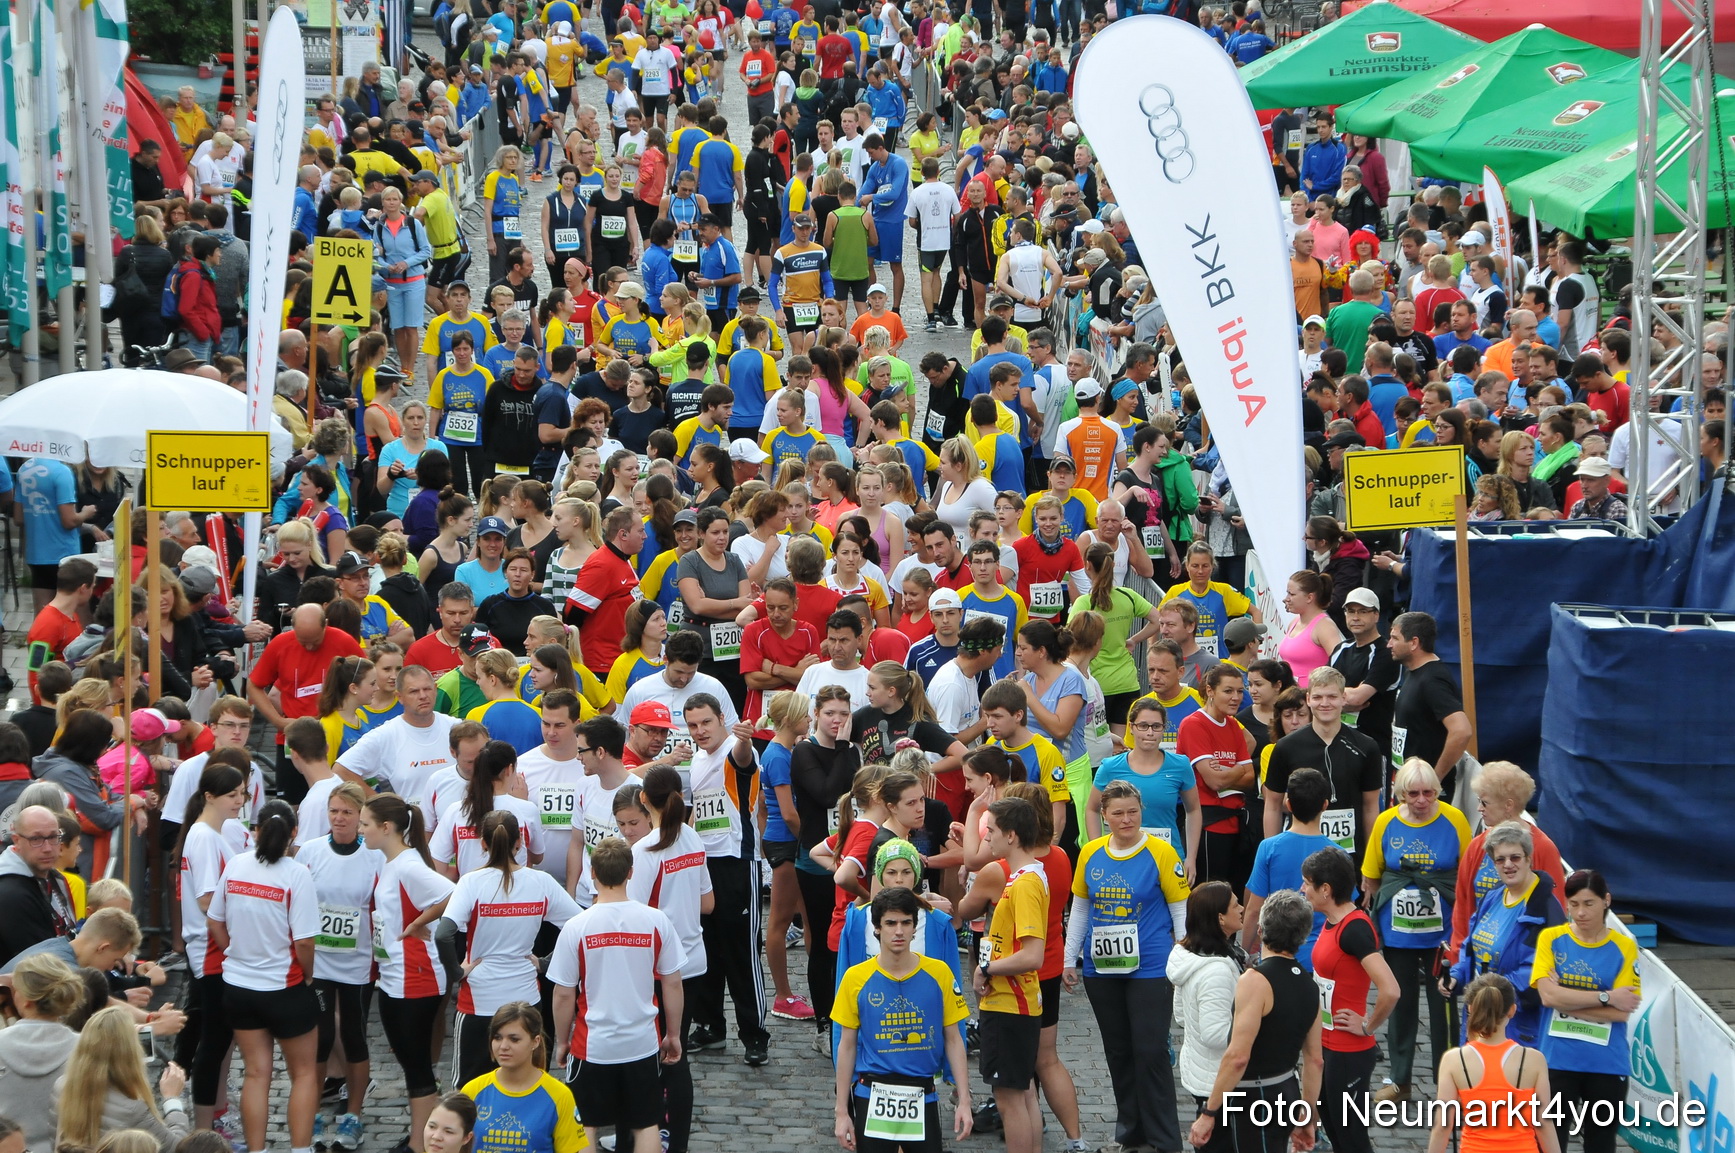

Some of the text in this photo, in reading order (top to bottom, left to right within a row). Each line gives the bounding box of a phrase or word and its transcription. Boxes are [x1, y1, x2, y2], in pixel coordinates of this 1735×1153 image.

[1344, 55, 1429, 67] Neumarkter
[1512, 127, 1589, 141] Neumarkter
[1482, 134, 1587, 154] Lammsbräu
[604, 221, 624, 230] 5227
[557, 234, 577, 243] 3409
[319, 238, 366, 260] Block
[679, 245, 693, 254] 140
[325, 264, 357, 307] A
[796, 307, 816, 317] 5147
[448, 418, 475, 431] 5532
[9, 439, 72, 457] Audi BKK
[156, 453, 261, 474] Schnupper-
[191, 475, 226, 492] lauf
[1353, 471, 1456, 493] Schnupper-
[1389, 491, 1422, 510] lauf
[1034, 592, 1061, 605] 5181
[543, 794, 575, 812] 519
[696, 799, 725, 819] 5114
[700, 821, 720, 829] Andreas
[1320, 820, 1350, 838] 045
[327, 907, 351, 917] Neumarkt
[321, 915, 355, 937] 205
[1407, 920, 1425, 928] Irene
[320, 936, 340, 948] Sonja
[1094, 936, 1133, 957] 5010
[1104, 959, 1126, 967] Claudia
[1566, 1023, 1593, 1035] Kerstin
[871, 1087, 918, 1098] PARTL Neumarkt
[873, 1096, 919, 1120] 5555
